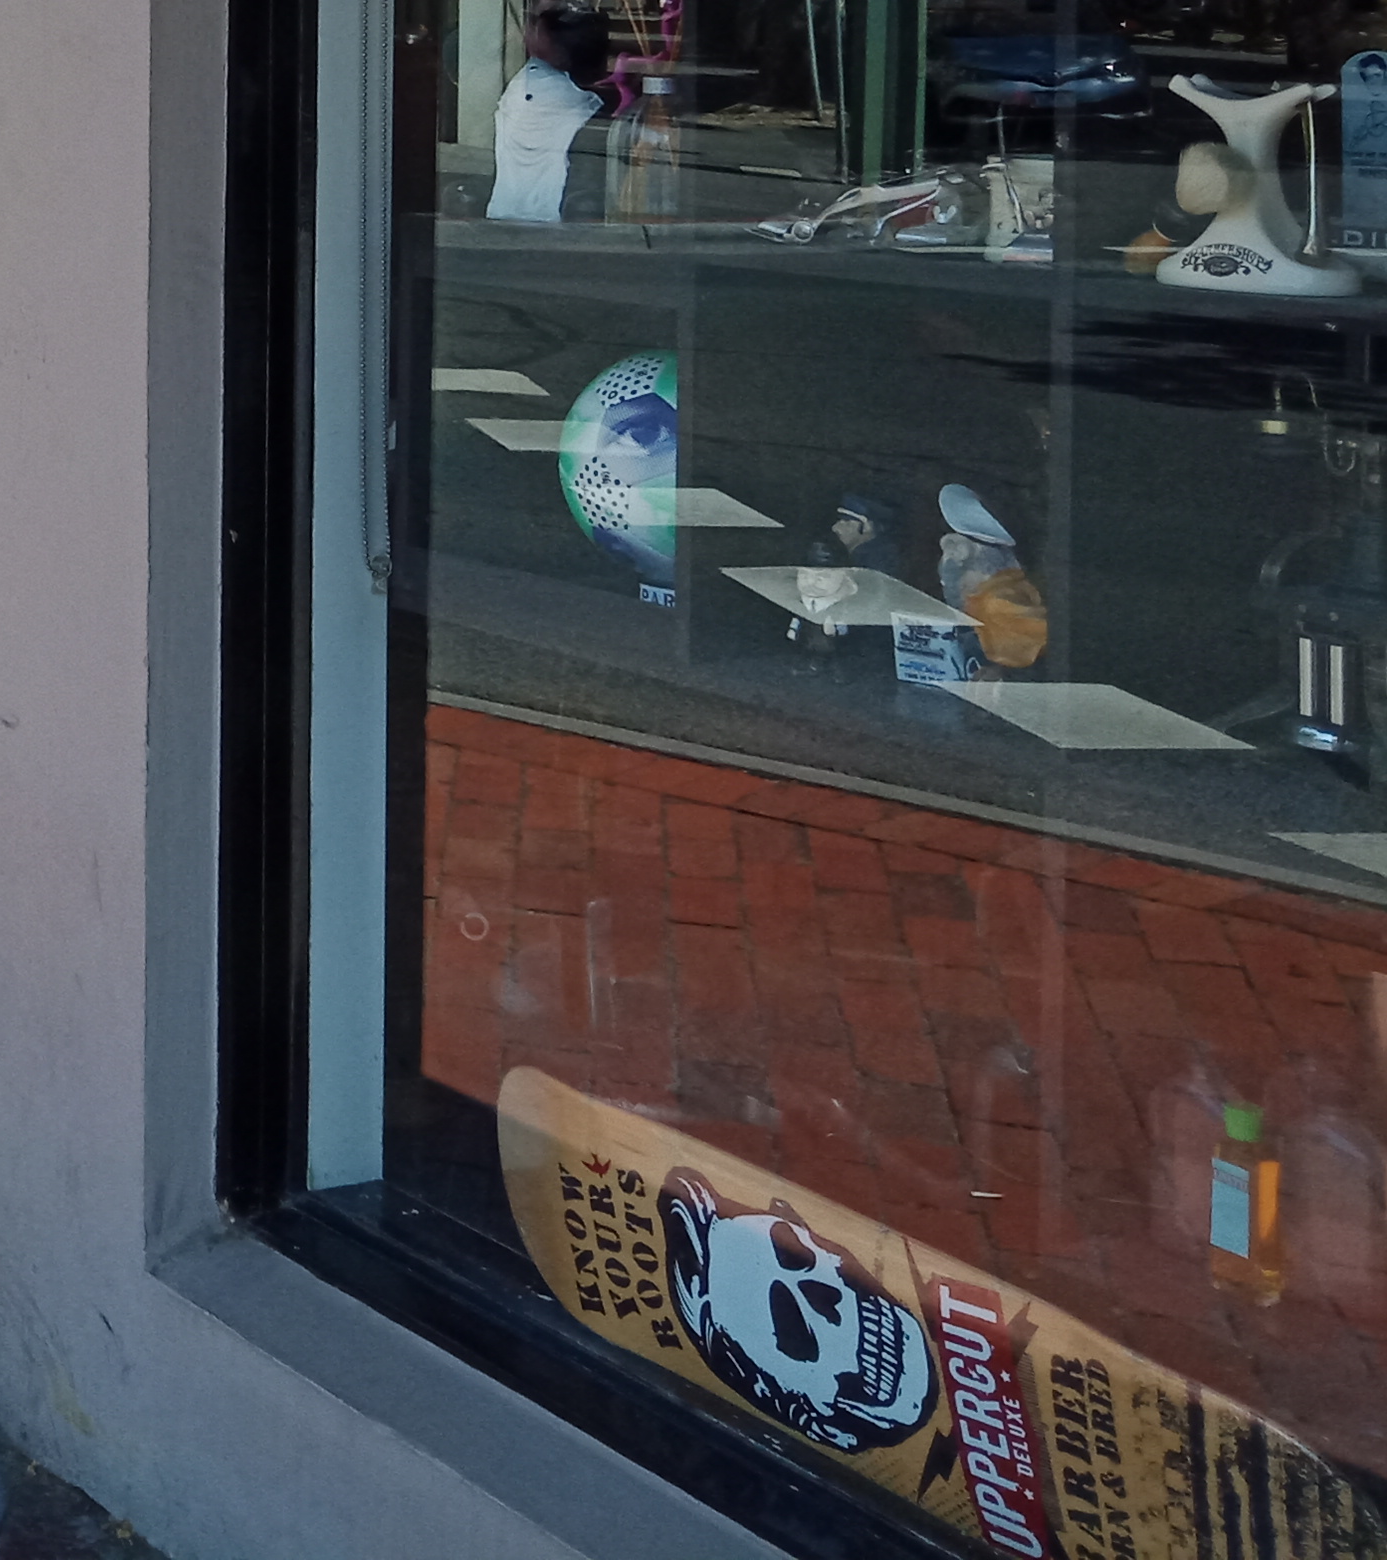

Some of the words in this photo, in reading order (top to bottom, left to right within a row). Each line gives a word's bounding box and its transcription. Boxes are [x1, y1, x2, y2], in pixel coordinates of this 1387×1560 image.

[558, 1162, 606, 1316] KNOW
[588, 1184, 641, 1319] YOUR
[616, 1168, 683, 1351] ROOTS
[938, 1284, 1043, 1559] UPPERCUT
[1003, 1395, 1034, 1478] DELUXE
[1085, 1358, 1121, 1465] BRED
